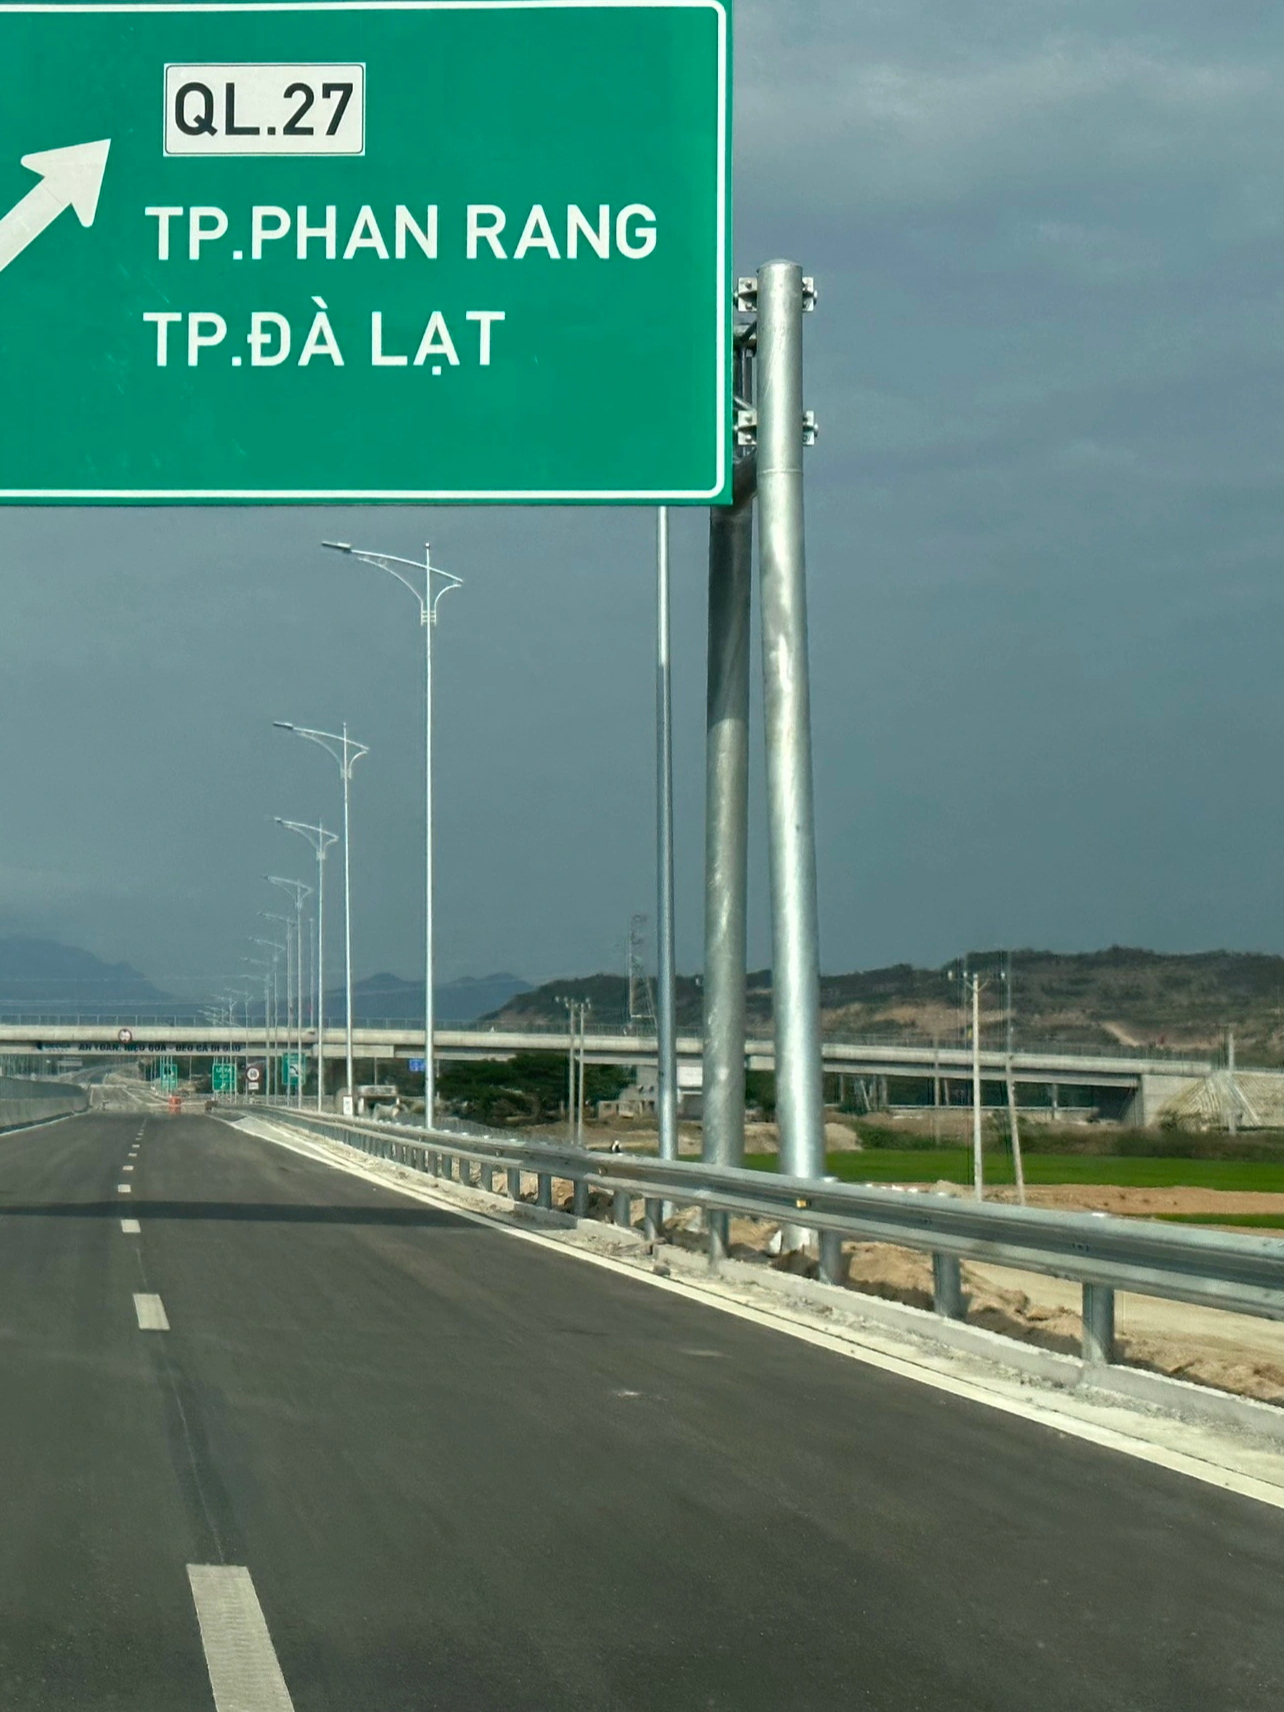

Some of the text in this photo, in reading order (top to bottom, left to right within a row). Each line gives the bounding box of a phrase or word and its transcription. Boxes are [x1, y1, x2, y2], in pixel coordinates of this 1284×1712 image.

[175, 82, 354, 136] QL.27
[145, 203, 657, 260] TP.PHAN RANG
[143, 296, 506, 375] TP.ĐÀ LẠT
